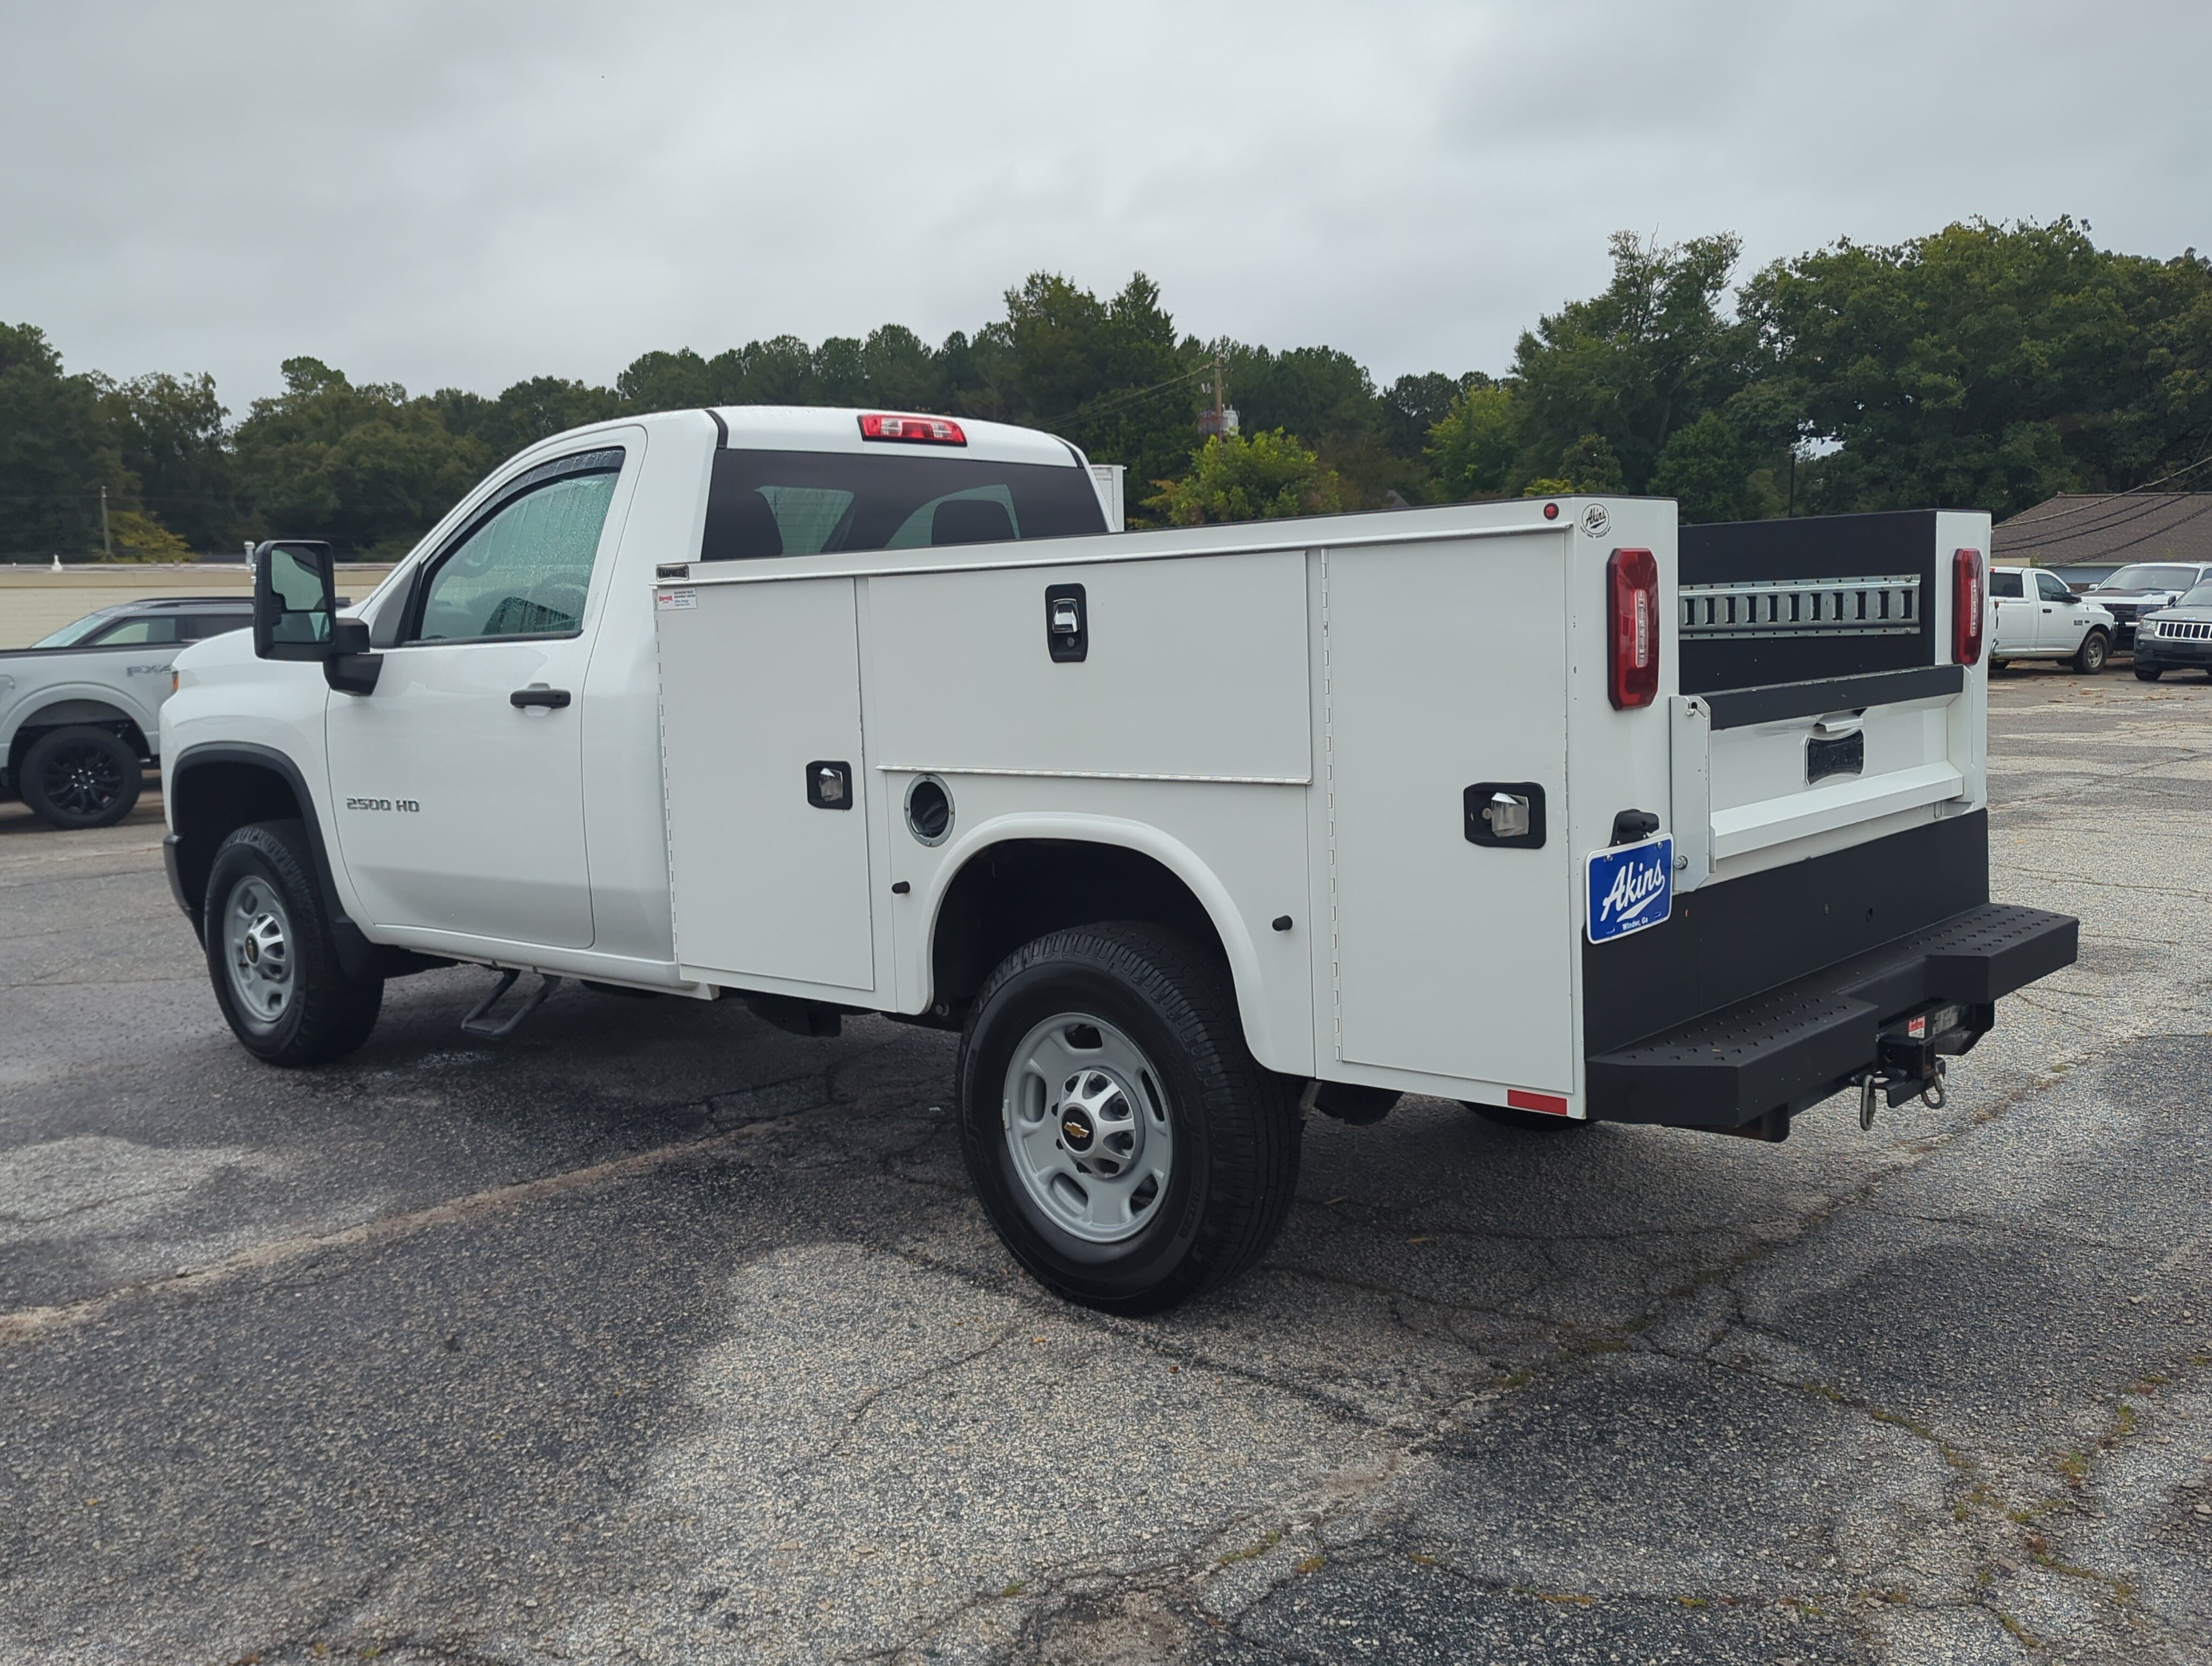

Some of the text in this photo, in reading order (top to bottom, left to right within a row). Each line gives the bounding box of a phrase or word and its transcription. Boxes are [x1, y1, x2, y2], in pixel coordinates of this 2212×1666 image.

[1586, 508, 1606, 527] Akins
[346, 797, 420, 812] 2500 HD
[1600, 858, 1665, 922] Akins
